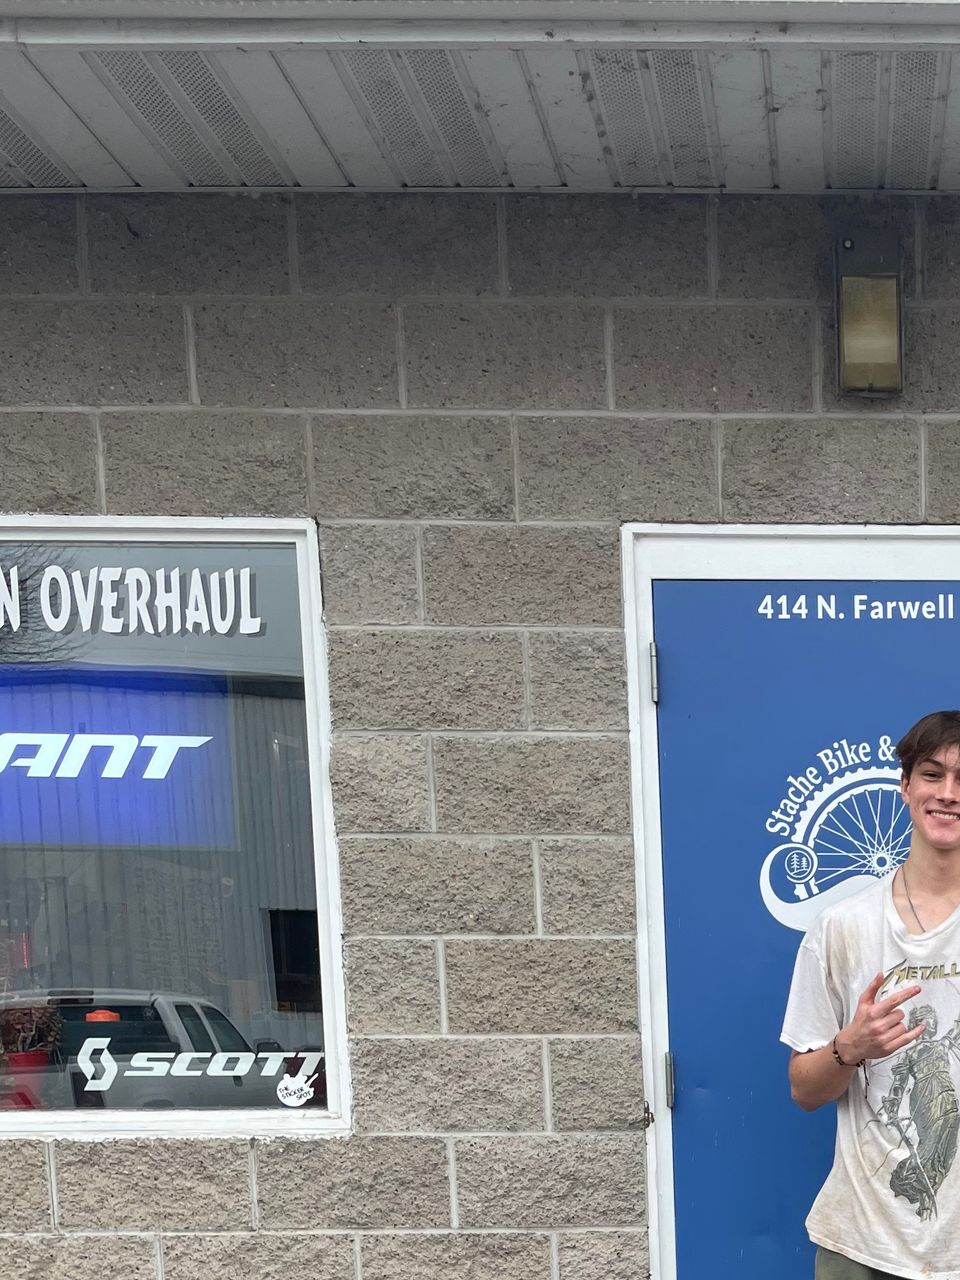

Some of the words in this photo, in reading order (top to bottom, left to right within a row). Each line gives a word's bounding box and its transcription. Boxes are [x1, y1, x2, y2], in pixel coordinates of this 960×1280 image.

[40, 565, 262, 635] OVERHAUL
[757, 594, 808, 620] 414
[817, 595, 845, 620] N.
[853, 594, 955, 620] Farwell
[765, 766, 823, 837] Stache
[816, 738, 872, 775] Bike
[878, 735, 897, 761] &
[123, 1051, 325, 1077] SCOTT
[296, 1090, 311, 1101] SPOT
